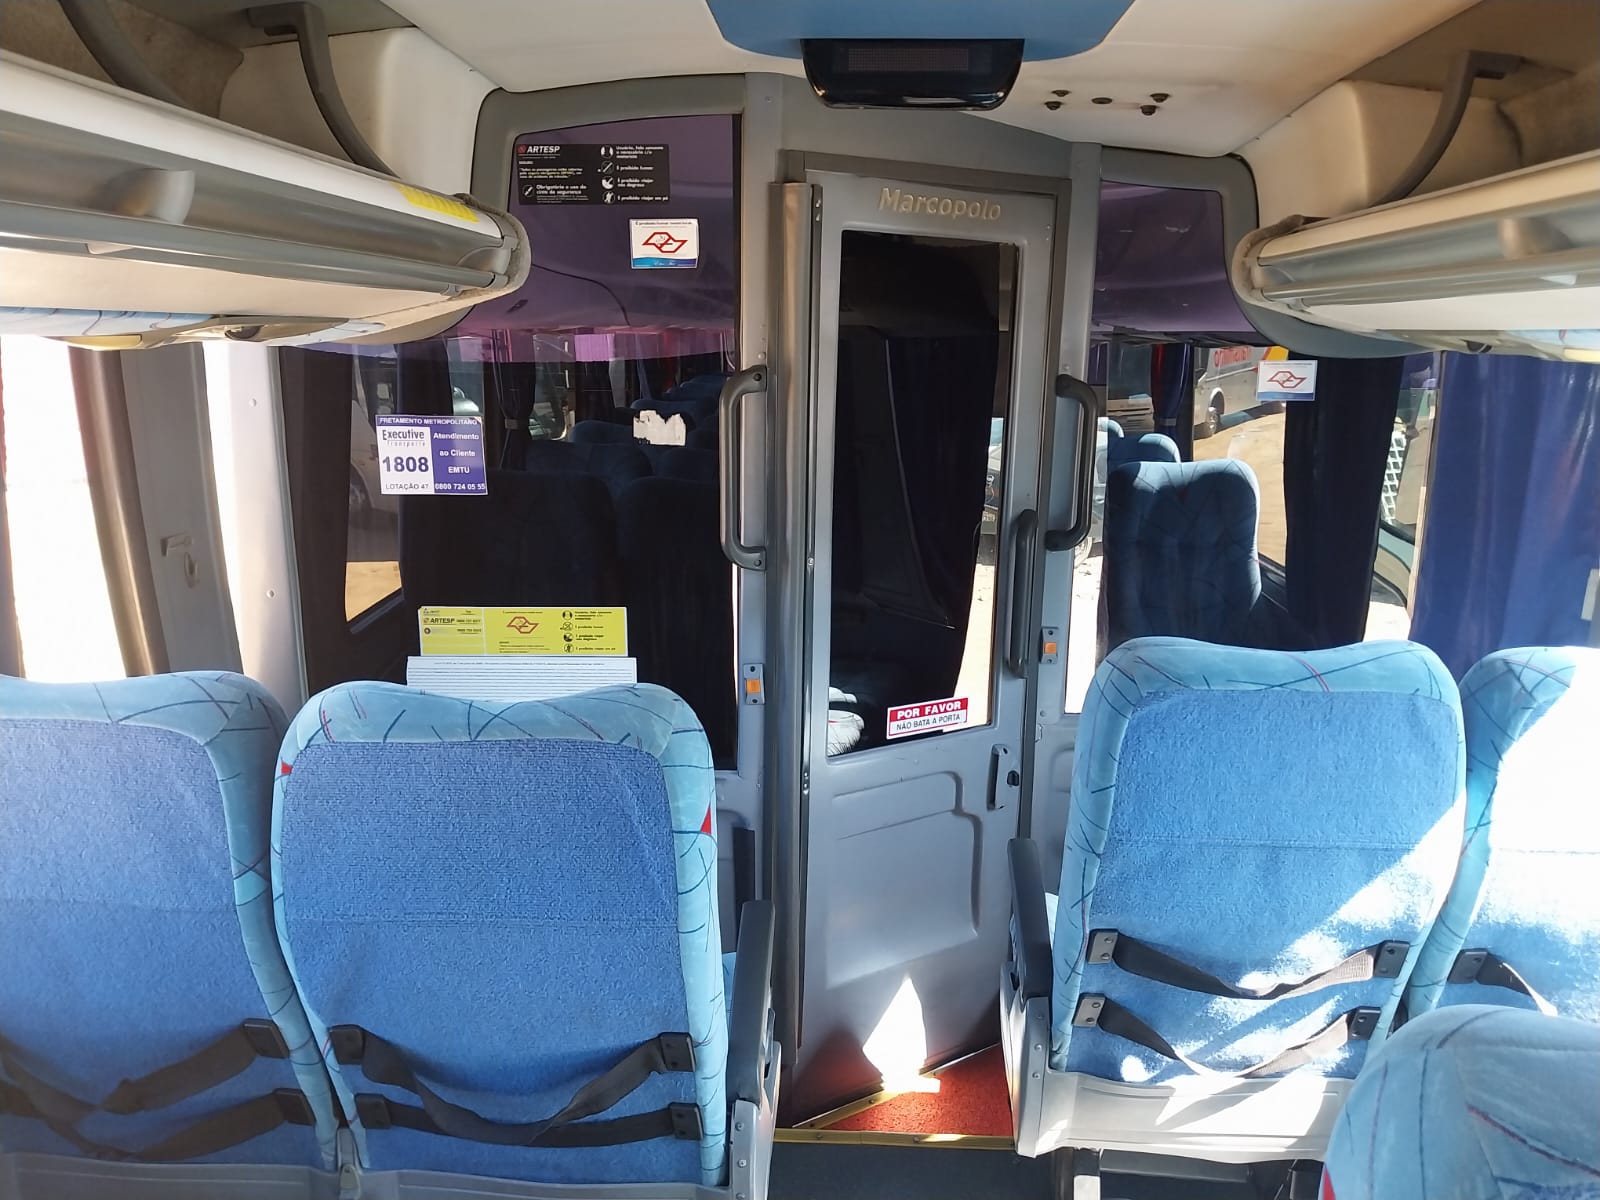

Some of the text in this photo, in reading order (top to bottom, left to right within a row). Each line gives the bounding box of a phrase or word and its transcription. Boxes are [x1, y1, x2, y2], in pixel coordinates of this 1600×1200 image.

[879, 187, 1001, 220] Marcopolo
[382, 429, 425, 440] Executive
[451, 449, 476, 457] Cliente
[382, 456, 429, 473] 1808
[448, 466, 470, 474] EMTU
[386, 482, 420, 491] LOTAÇÃO
[897, 701, 961, 720] POR FAVOR
[896, 722, 912, 731] NÃO
[914, 719, 930, 728] BATA
[938, 713, 960, 723] PORTA
